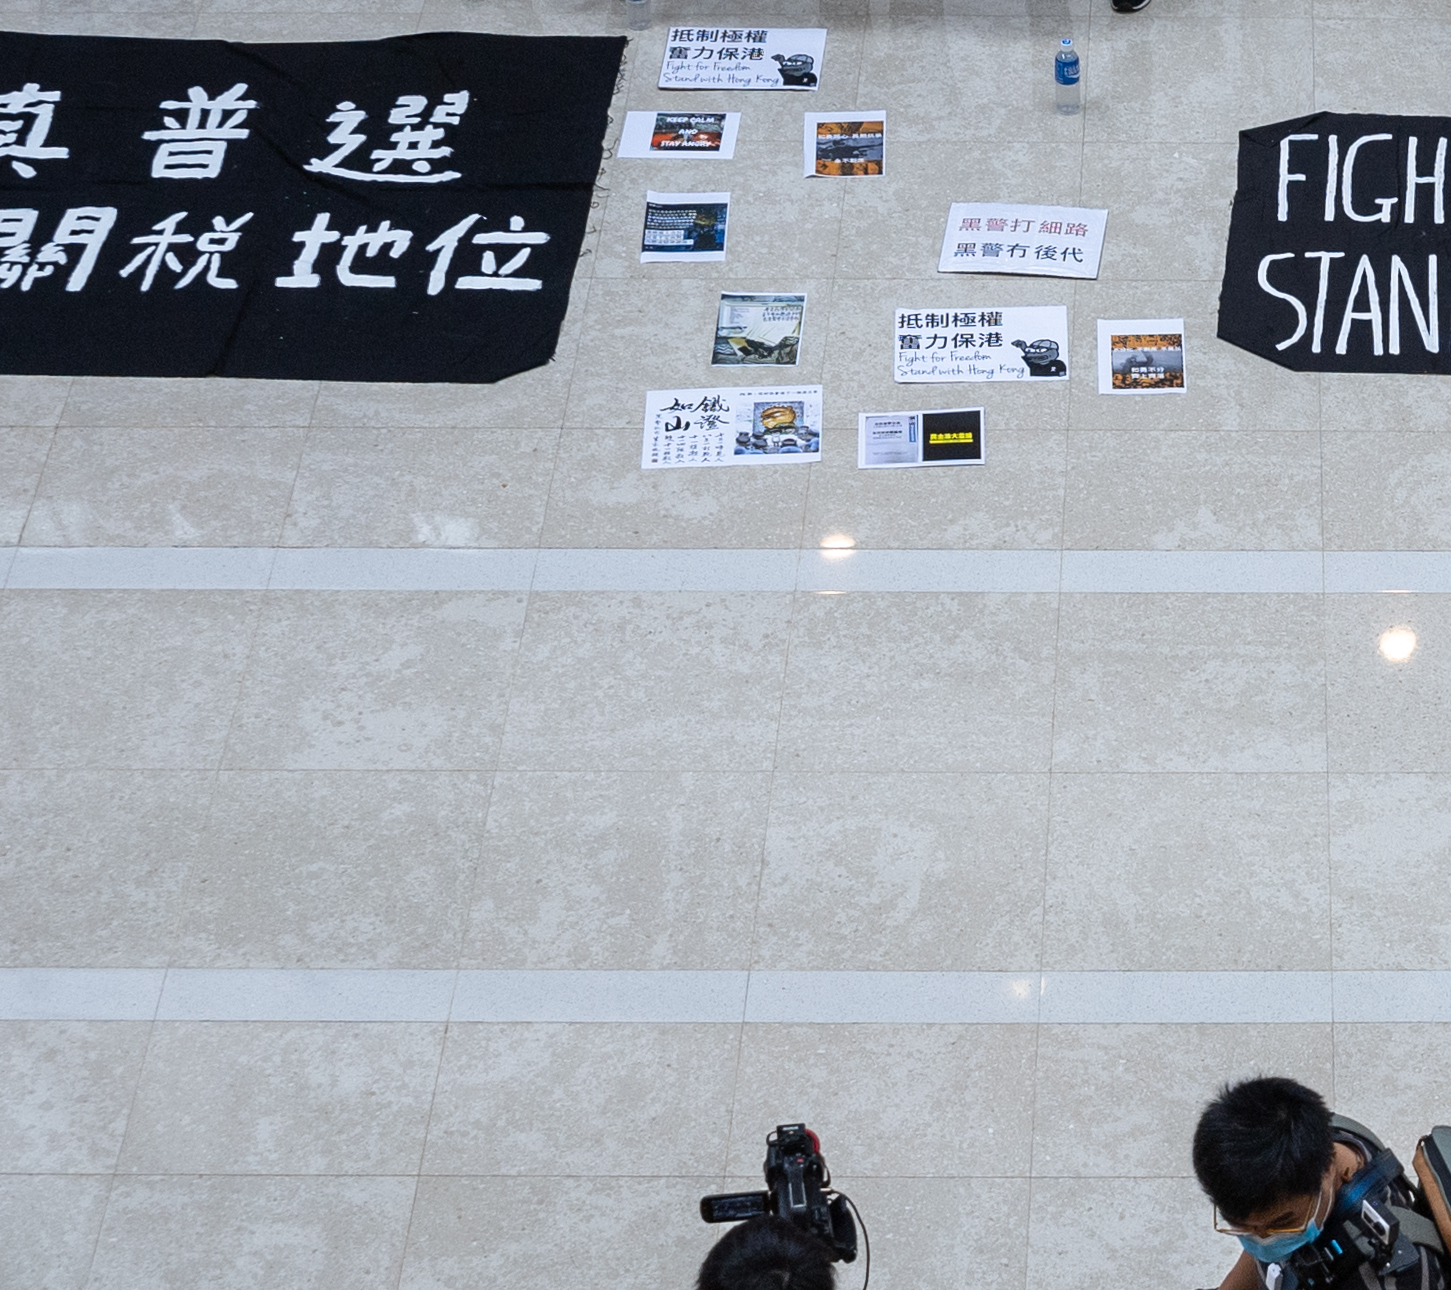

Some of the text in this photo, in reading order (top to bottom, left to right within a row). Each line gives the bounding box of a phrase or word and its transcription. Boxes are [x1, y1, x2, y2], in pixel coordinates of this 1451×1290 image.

[670, 28, 769, 44] 抵制極權
[668, 46, 765, 61] 奮力保港
[666, 61, 691, 72] Fight
[696, 62, 709, 71] for
[727, 73, 752, 87] Hong
[756, 74, 779, 87] Kong
[959, 218, 1089, 237] 黑警打細路
[954, 242, 1083, 263] 黑警冇後代
[898, 312, 1003, 329] 抵制極權
[899, 333, 1003, 349] 奮力保港
[899, 351, 927, 365] Fight
[931, 351, 945, 363] for
[968, 364, 996, 378] Hong
[999, 365, 1025, 378] Kong
